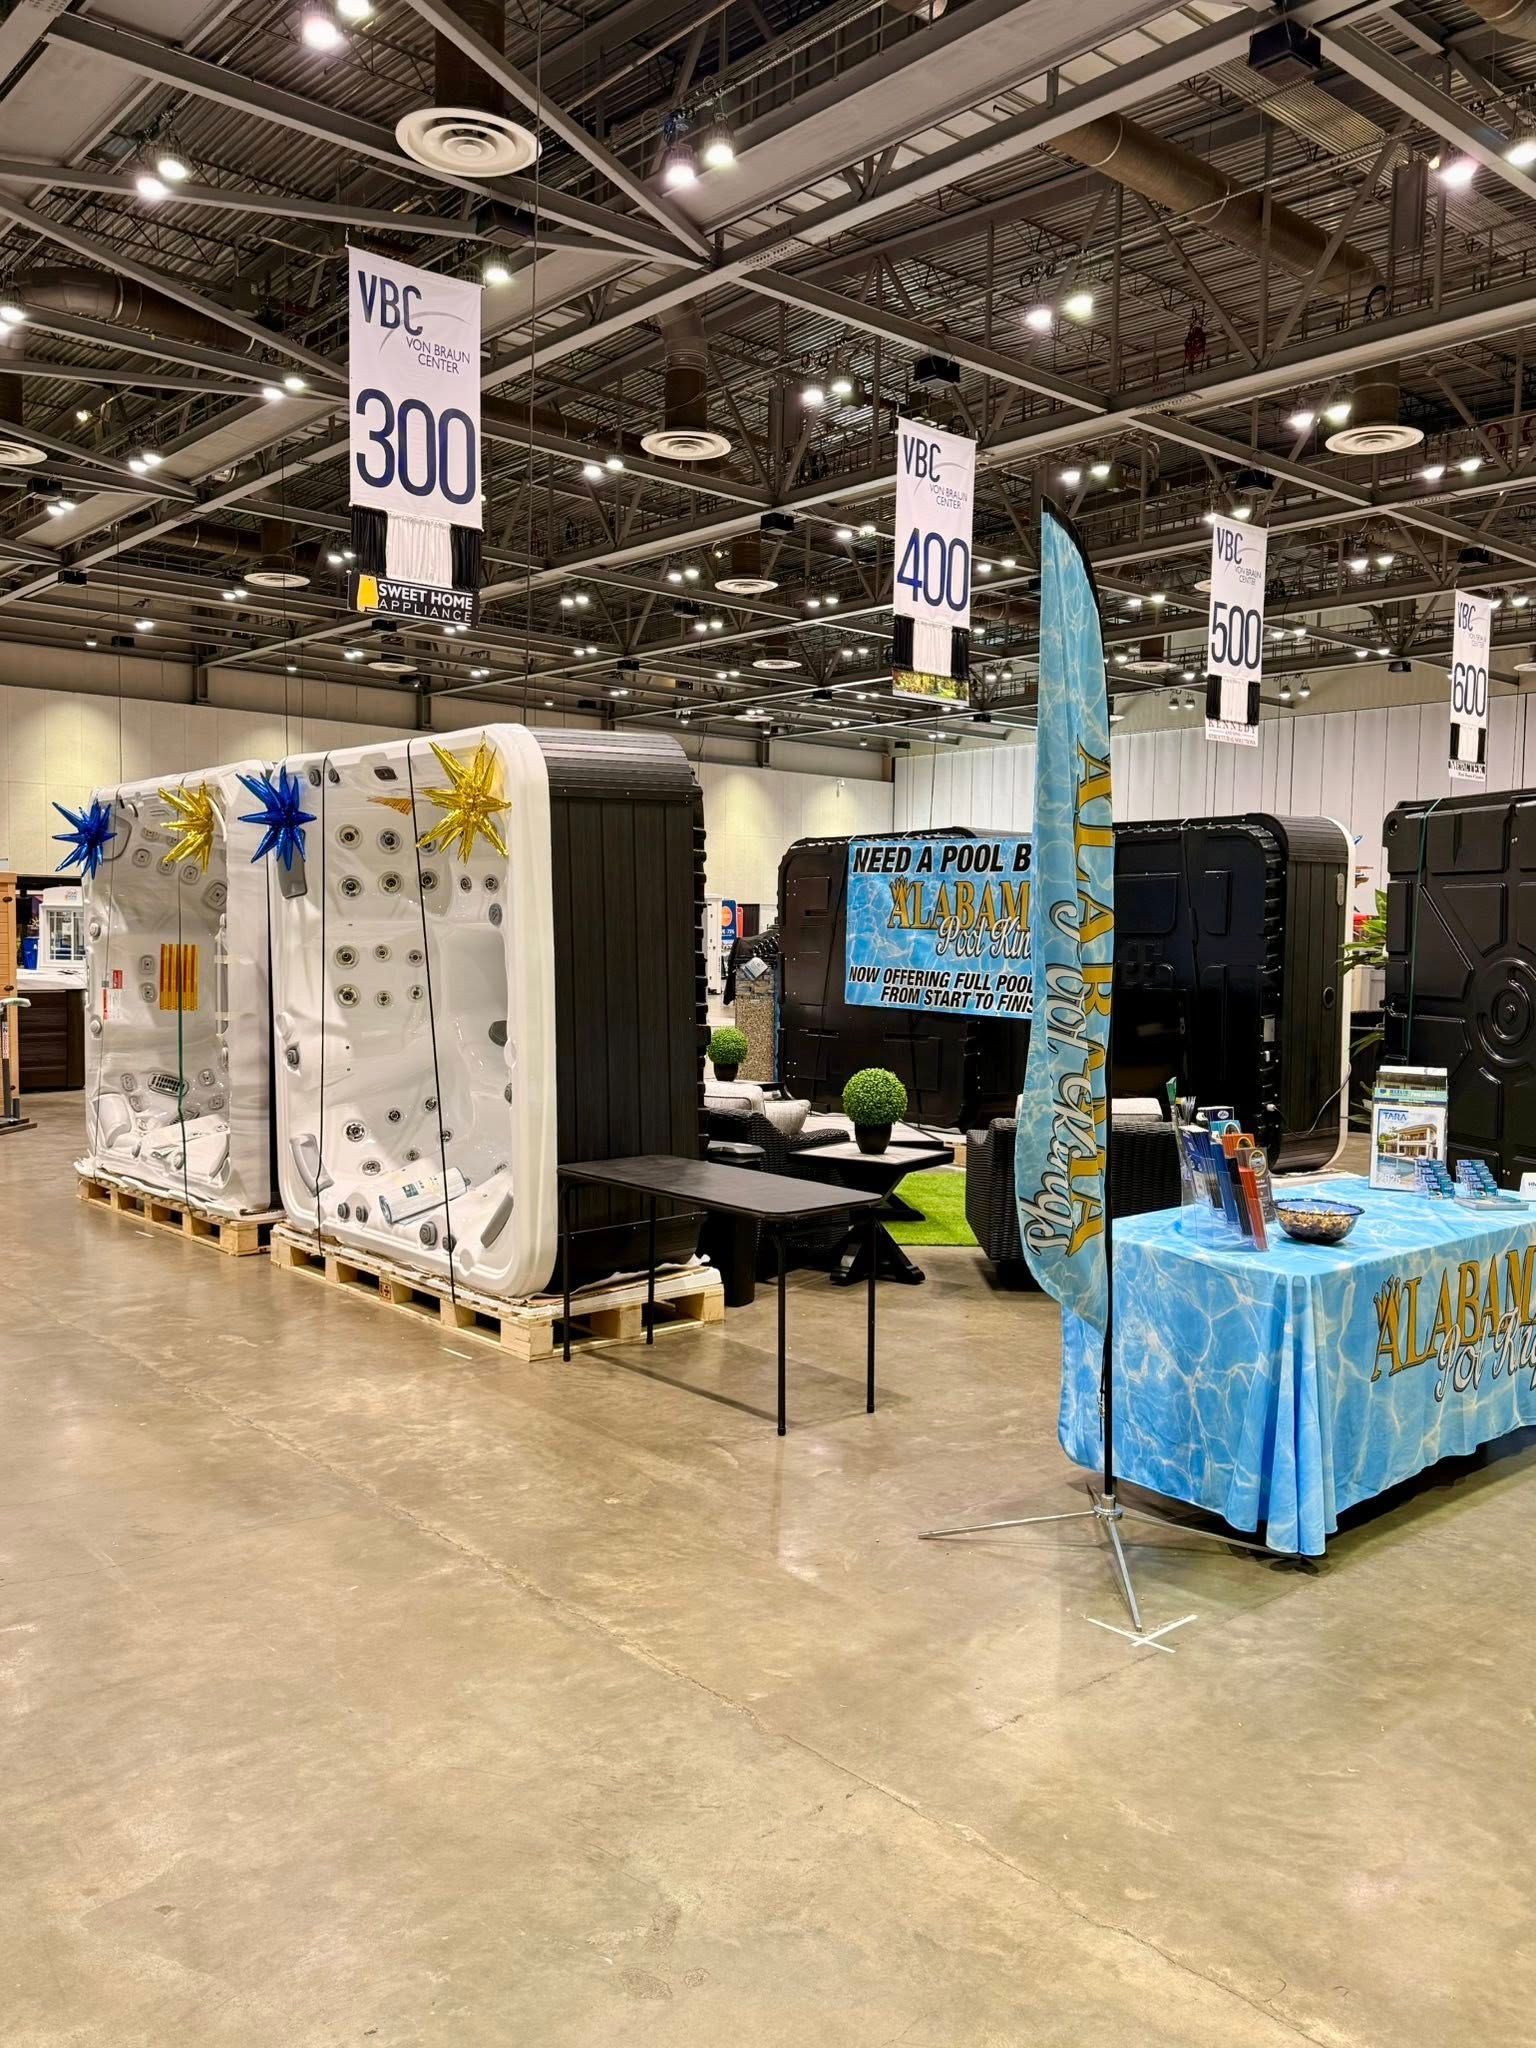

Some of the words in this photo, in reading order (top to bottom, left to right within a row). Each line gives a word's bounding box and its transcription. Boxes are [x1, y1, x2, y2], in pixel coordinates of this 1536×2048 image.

[358, 270, 422, 336] VBC
[406, 336, 431, 354] VON
[434, 344, 470, 364] BRAUN
[418, 353, 459, 375] CENTER
[356, 388, 476, 505] 300
[903, 434, 941, 482] VBC
[929, 484, 944, 495] VON
[936, 495, 961, 509] CENTER
[1216, 527, 1243, 565] VBC
[897, 528, 970, 612] 400
[378, 583, 427, 602] SWEET
[430, 591, 473, 610] HOME
[378, 598, 472, 622] APPLIANCE
[1457, 601, 1476, 632] VBC
[1211, 601, 1261, 669] 500
[1453, 662, 1487, 717] 600
[853, 846, 912, 873] NEED
[916, 846, 932, 873] A
[940, 844, 1004, 872] POOL
[936, 915, 985, 958] Pool
[849, 966, 880, 982] NOW
[883, 968, 950, 988] OFFERING
[954, 972, 991, 991] FULL
[881, 985, 920, 1004] FROM
[924, 989, 972, 1008] START
[975, 991, 994, 1010] TO
[1371, 1245, 1536, 1382] ALABAM
